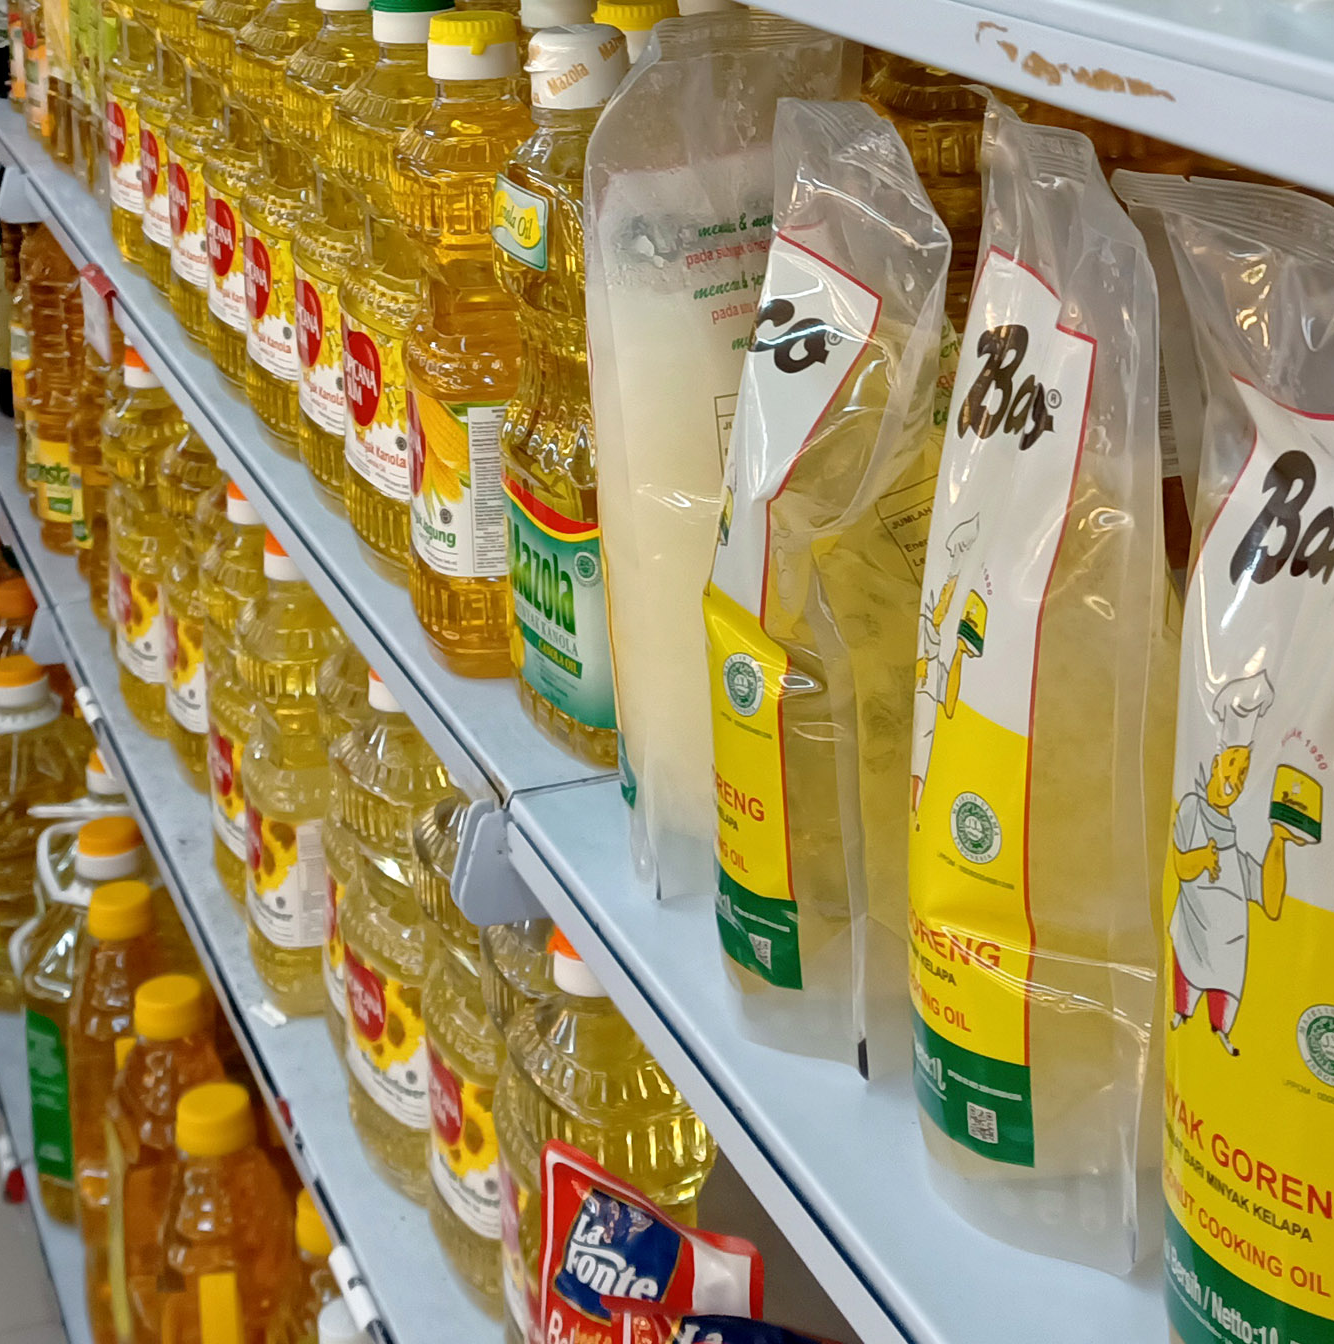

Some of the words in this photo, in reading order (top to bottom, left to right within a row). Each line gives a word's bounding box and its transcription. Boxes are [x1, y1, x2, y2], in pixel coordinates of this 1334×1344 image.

[546, 63, 590, 97] Mazola
[517, 216, 534, 241] Oil
[711, 305, 738, 325] pada
[375, 442, 408, 469] Kanola
[890, 507, 933, 532] JUMLAH
[541, 624, 579, 657] KANOLA
[729, 848, 750, 874] OIL
[943, 1005, 972, 1034] OIL
[1205, 1168, 1251, 1214] MINYAK
[1252, 1202, 1313, 1244] KELAPA
[574, 1212, 605, 1245] La
[1197, 1206, 1283, 1278] COOKING
[1289, 1264, 1332, 1299] OIL
[564, 1241, 660, 1302] Fonte
